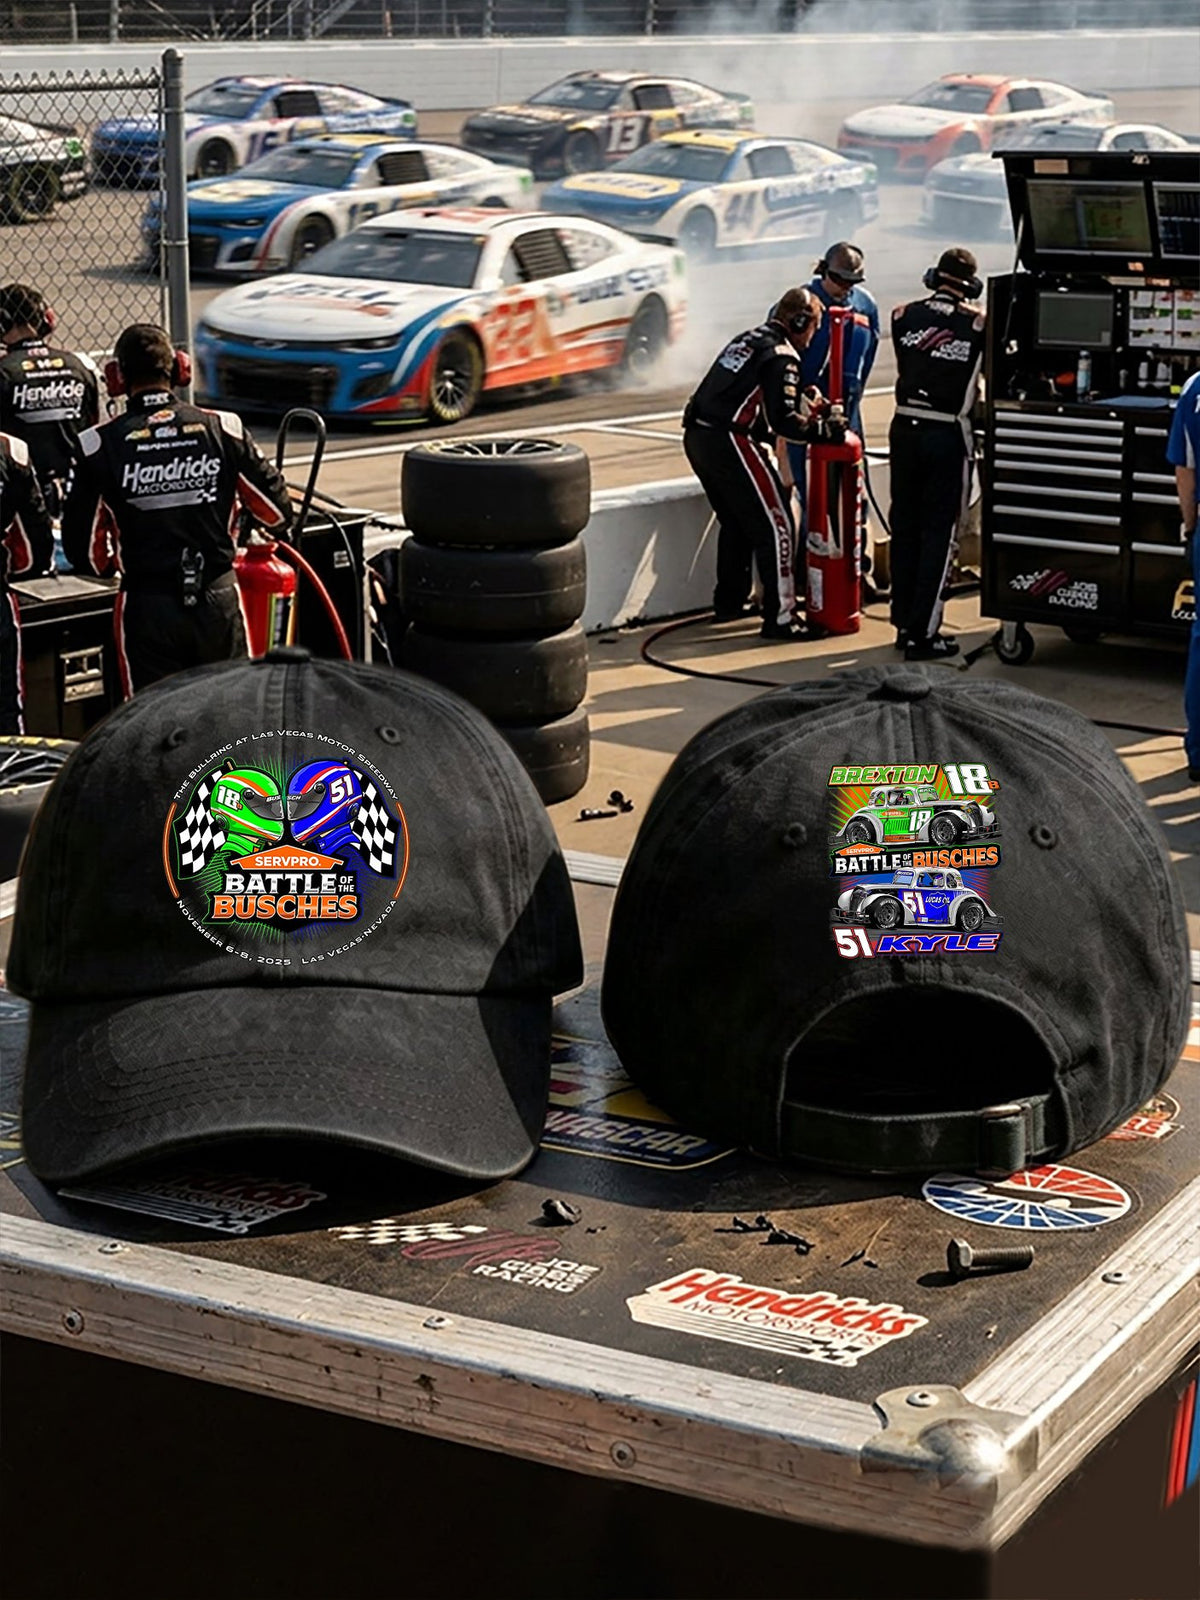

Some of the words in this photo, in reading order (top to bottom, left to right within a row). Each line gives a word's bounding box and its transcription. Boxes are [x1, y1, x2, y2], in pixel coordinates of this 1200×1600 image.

[605, 117, 645, 152] 13
[173, 780, 190, 800] THE
[188, 743, 233, 779] BULLRING
[235, 736, 249, 746] AT
[251, 731, 274, 740] LAS
[277, 730, 314, 739] VEGAS
[317, 734, 356, 755] MOTOR
[357, 753, 399, 800] SPEEDWAY
[829, 764, 939, 786] BREXTON
[217, 785, 241, 811] 18
[329, 774, 355, 804] 51
[835, 854, 902, 874] BATTLE
[912, 847, 999, 868] BUSCHES
[845, 847, 875, 855] SERVPRO
[223, 873, 338, 894] BATTLE
[340, 876, 353, 884] OF
[338, 884, 355, 892] THE
[211, 895, 358, 919] BUSCHES
[903, 891, 927, 916] 51
[925, 896, 942, 904] LUCAS
[177, 900, 224, 948] NOVEMBER
[257, 956, 292, 966] 2025
[833, 927, 874, 959] 51
[878, 933, 1000, 952] KYLE
[301, 954, 325, 965] LAS
[544, 1110, 707, 1155] NASCAR
[472, 1264, 578, 1292] RACING
